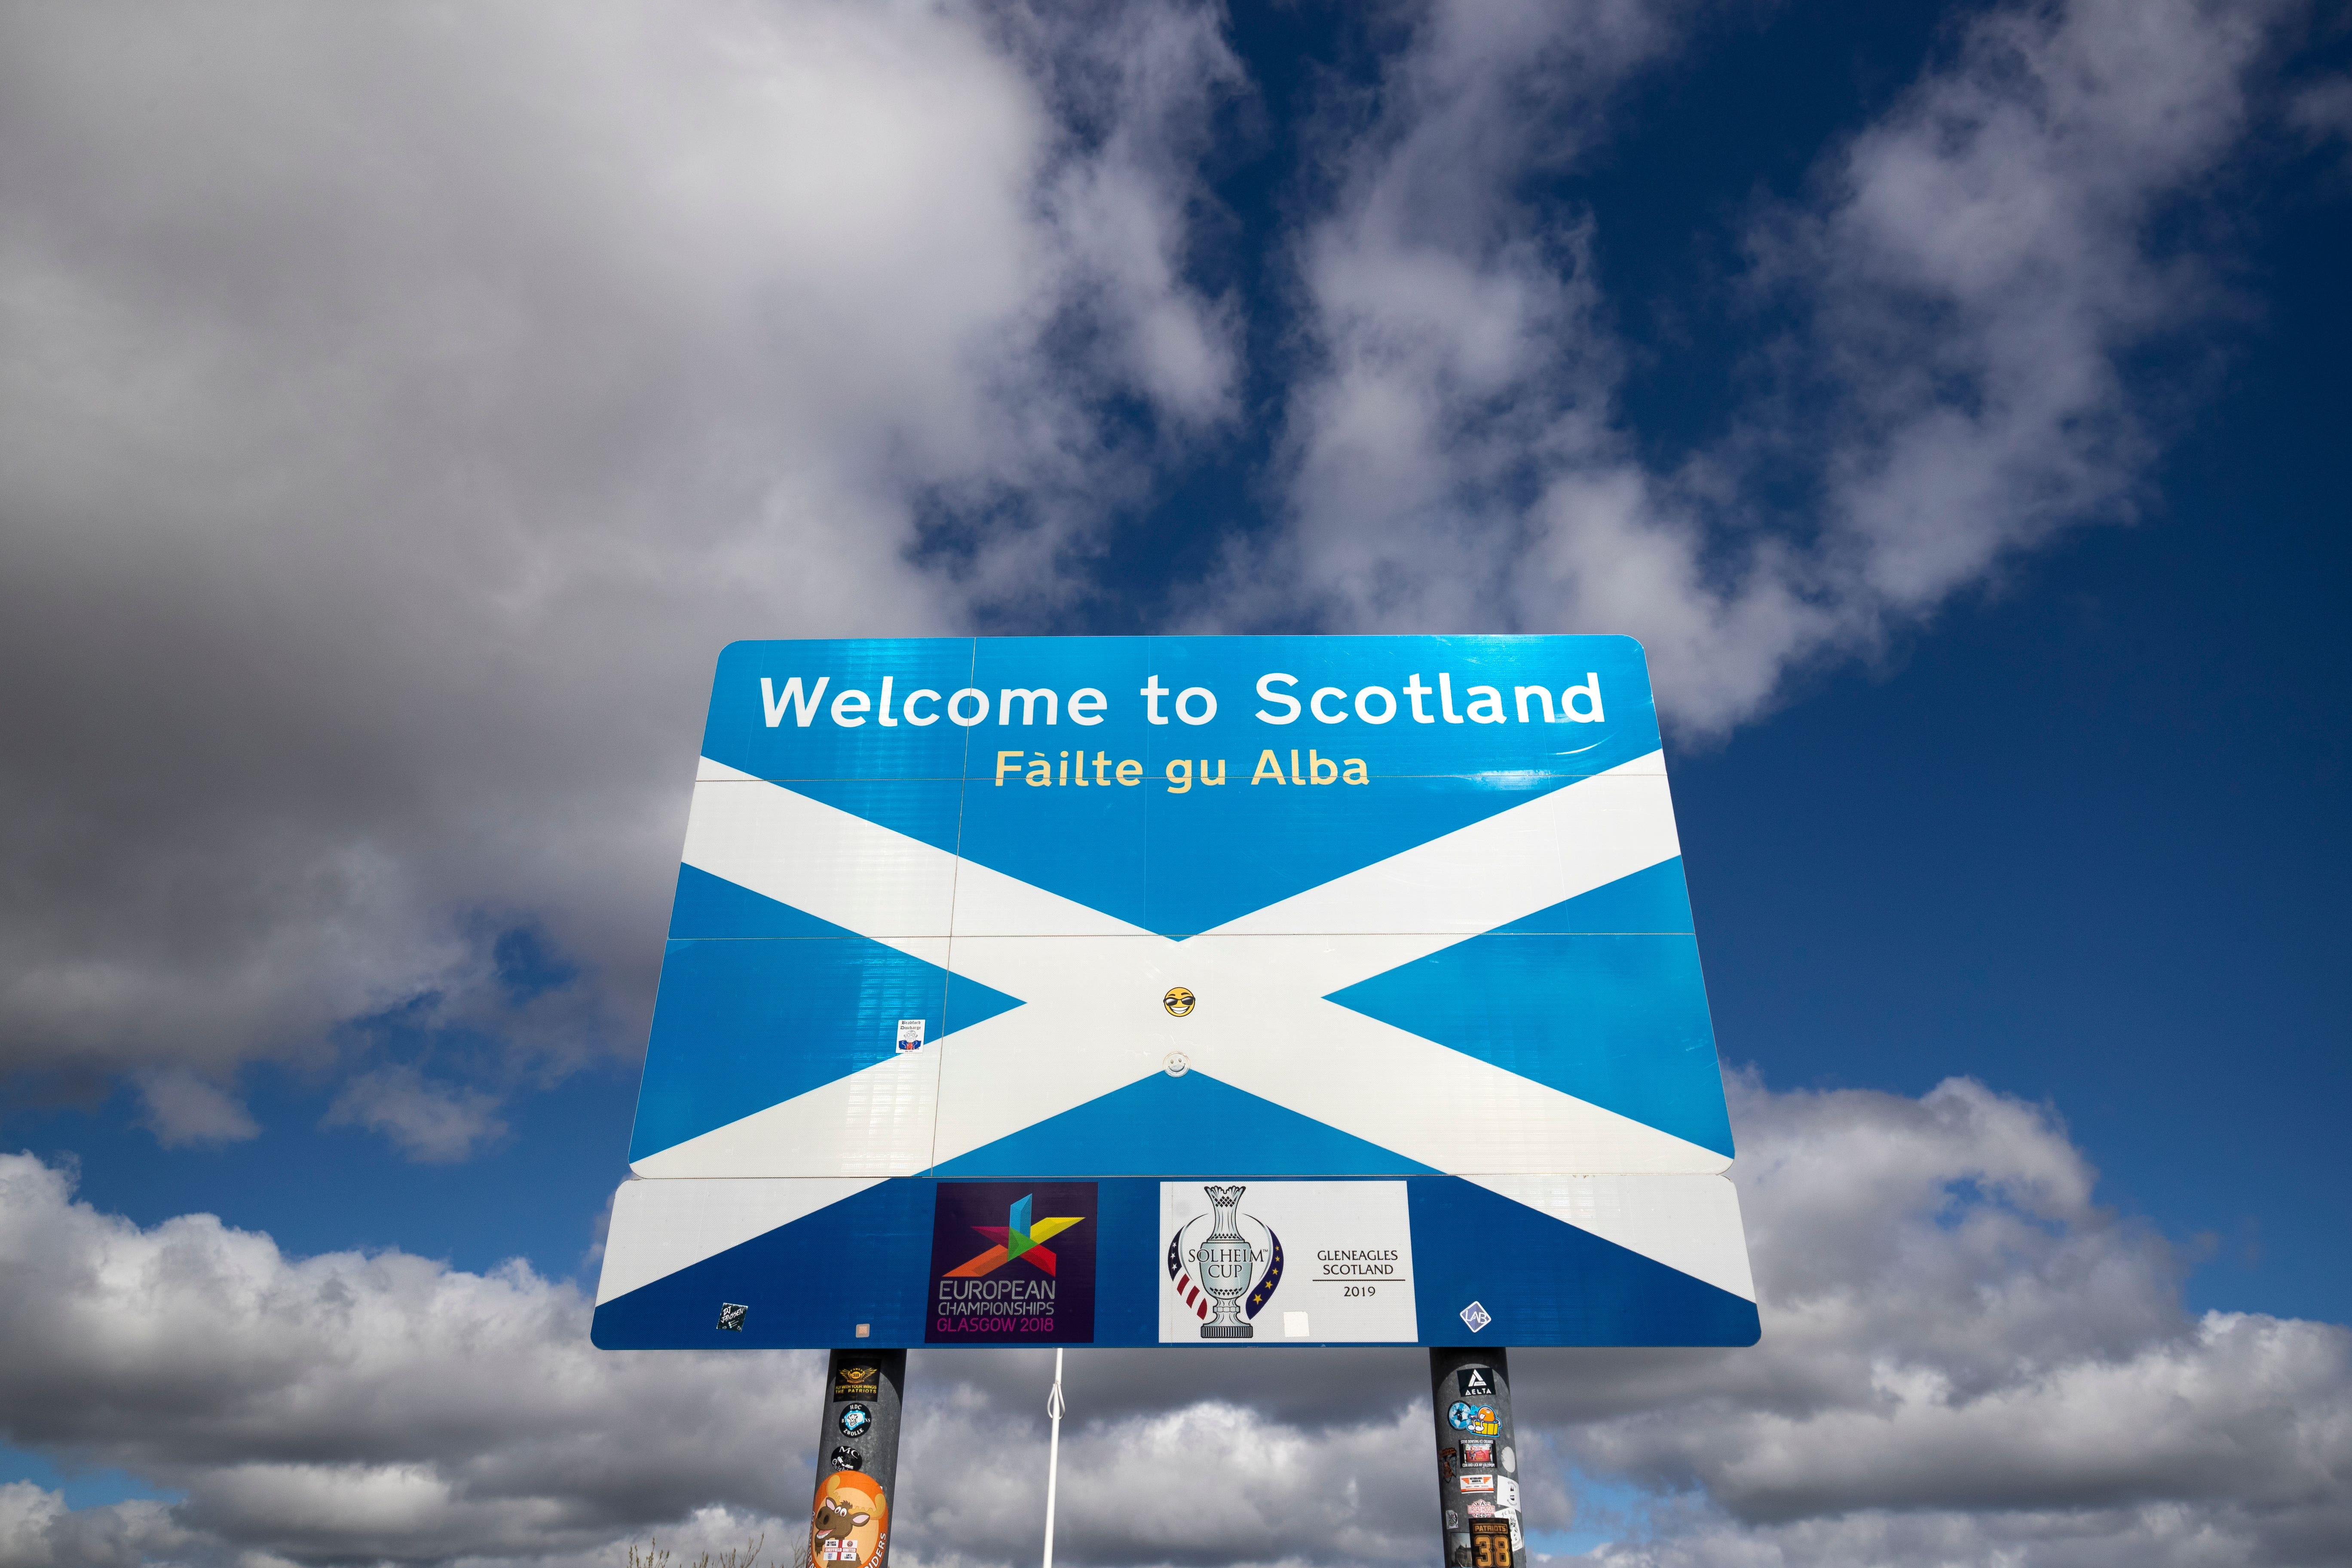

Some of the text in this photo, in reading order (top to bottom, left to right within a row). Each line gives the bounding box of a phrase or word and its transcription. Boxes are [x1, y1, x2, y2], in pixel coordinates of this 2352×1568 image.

[760, 672, 1605, 727] Welcome to Scotland
[995, 749, 1370, 794] Fàilte gu Alba
[1188, 1249, 1264, 1262] SOLHEIM
[1317, 1250, 1398, 1260] GLENEAGLES
[1208, 1265, 1242, 1278] CUP
[1323, 1265, 1393, 1275] SCOTLAND
[939, 1280, 1056, 1299] EUROPEAN
[1344, 1286, 1375, 1297] 2019
[723, 1306, 732, 1316] DJ
[938, 1302, 1054, 1315] CHAMPIONSHIPS
[720, 1308, 744, 1323] JANSSEN
[1465, 1310, 1488, 1324] LAB
[937, 1318, 1054, 1332] GLASGOW 2018
[843, 1428, 864, 1436] ZWOLLE
[839, 1446, 860, 1459] MC
[1474, 1535, 1511, 1568] 38
